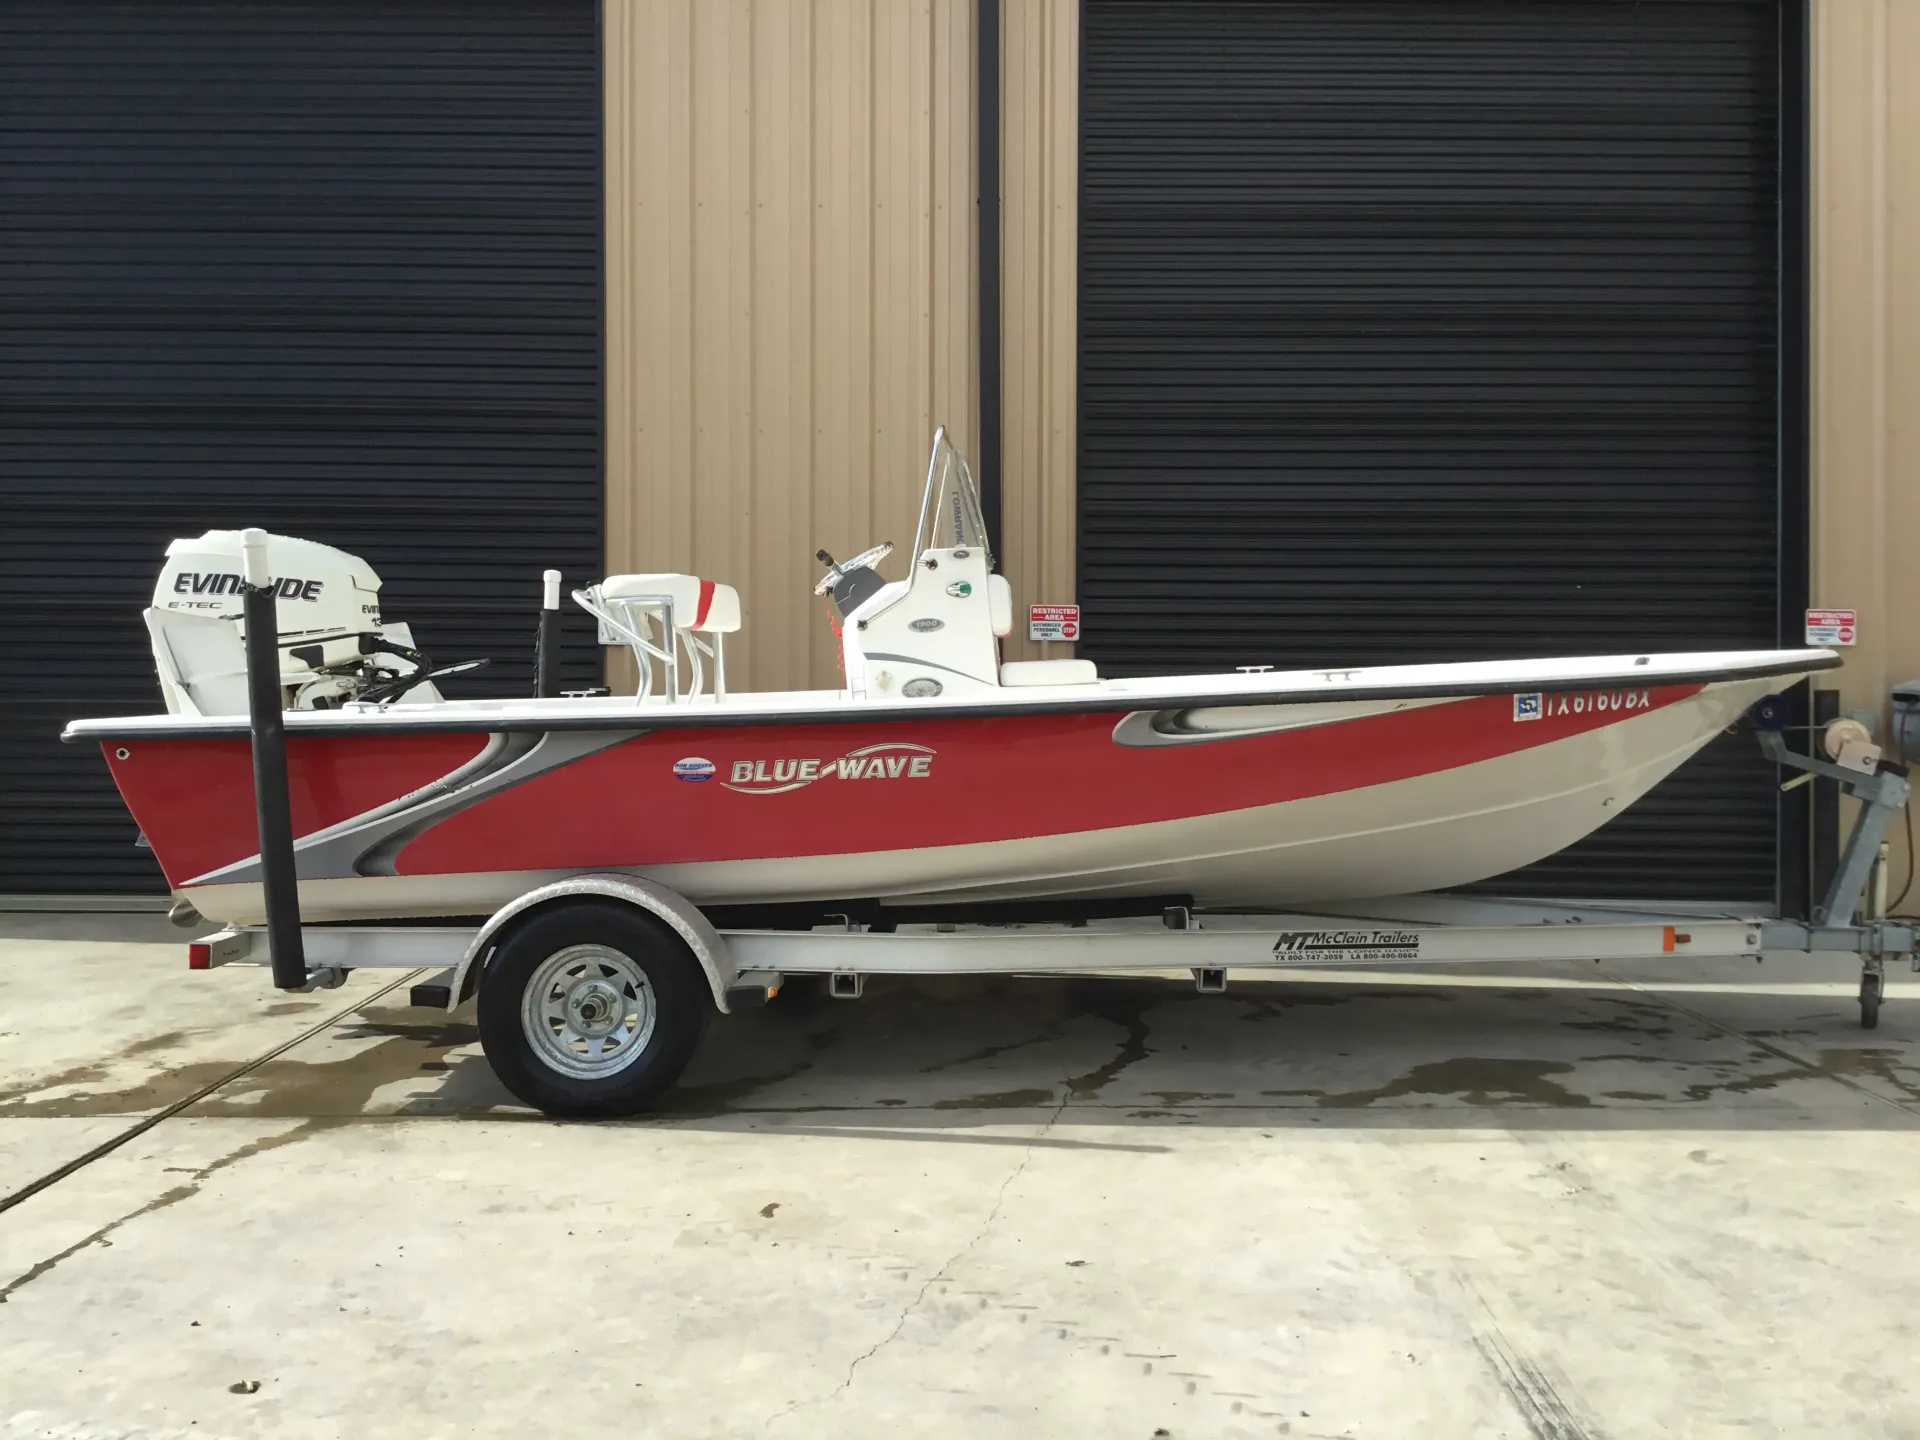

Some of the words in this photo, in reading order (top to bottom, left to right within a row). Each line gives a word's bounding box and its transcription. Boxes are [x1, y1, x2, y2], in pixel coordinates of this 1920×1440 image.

[168, 601, 223, 609] E-TEC
[1032, 607, 1077, 615] RESTRICTED
[731, 759, 821, 783] BLUE
[836, 755, 932, 780] WAVE
[1311, 931, 1368, 944] McClain
[1371, 931, 1420, 943] Trailers
